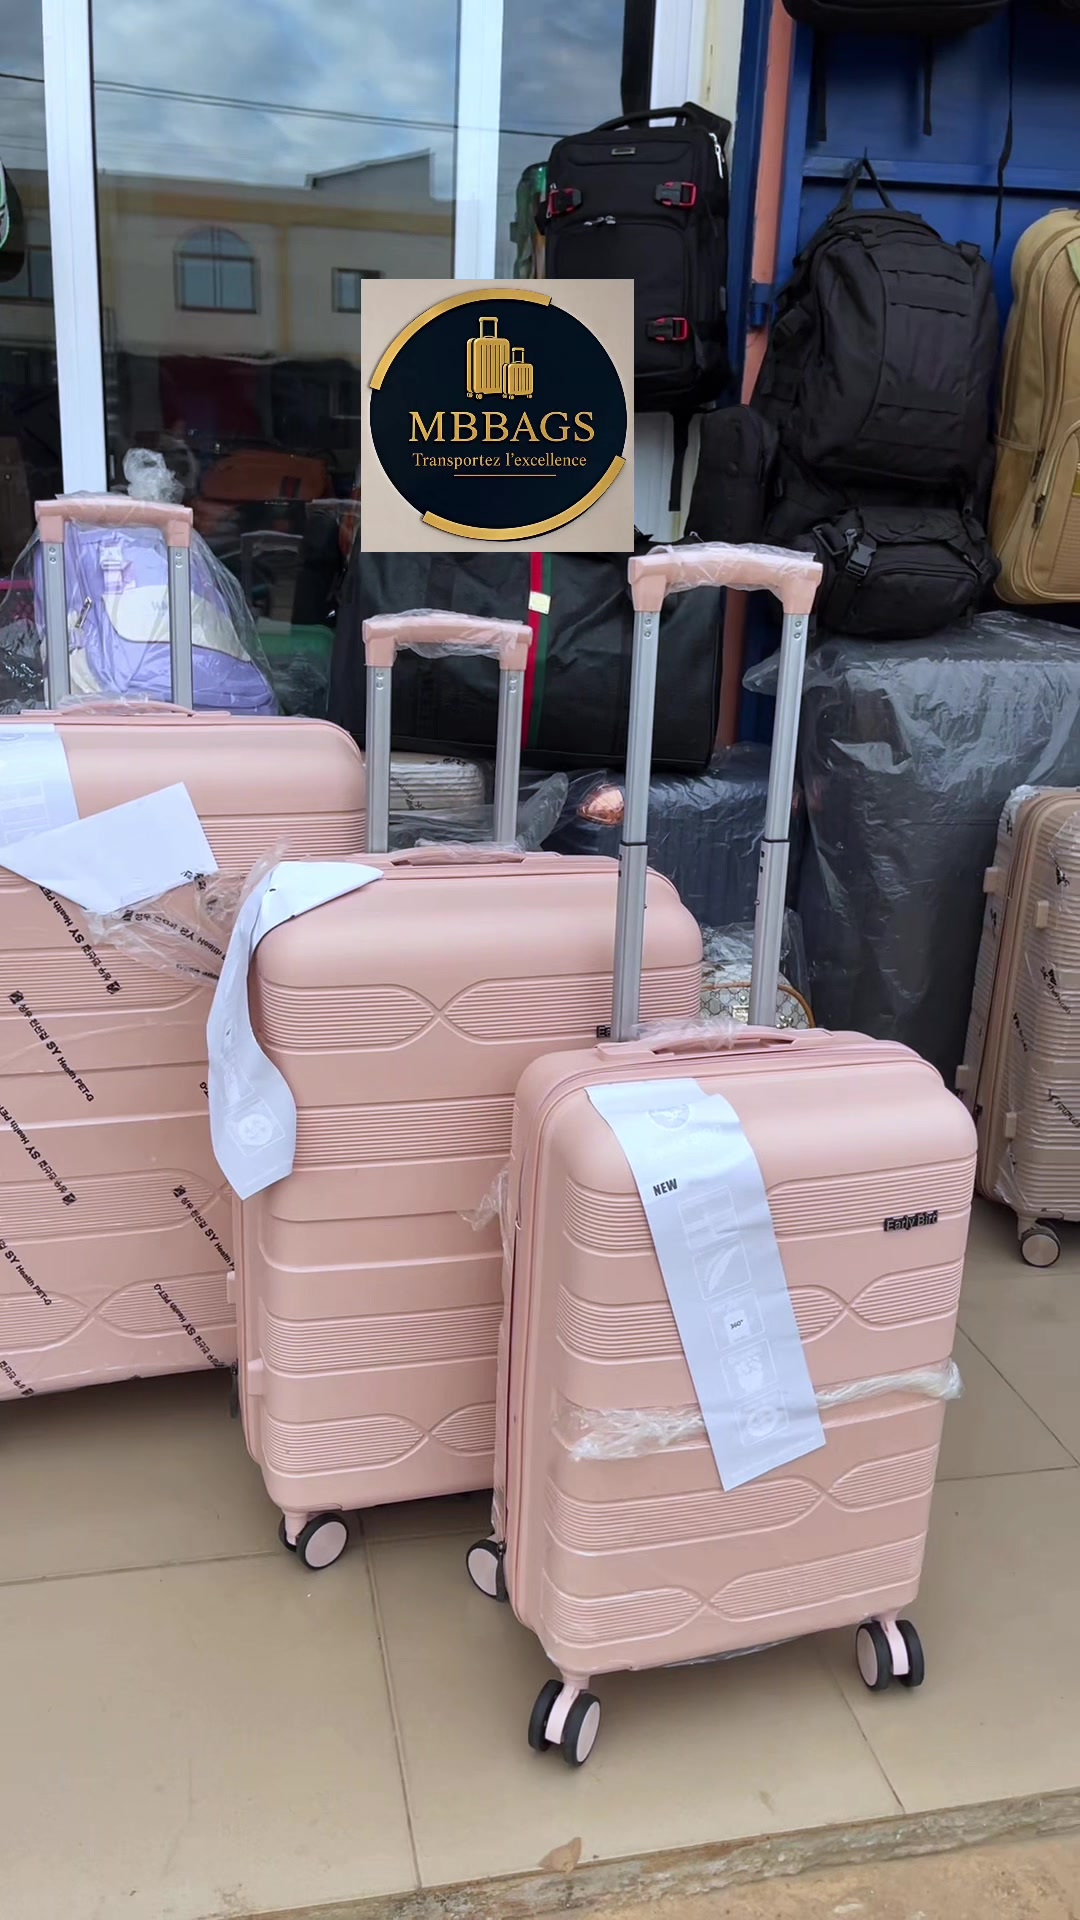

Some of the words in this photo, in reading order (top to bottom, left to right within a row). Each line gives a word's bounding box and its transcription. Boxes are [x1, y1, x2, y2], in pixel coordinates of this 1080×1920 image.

[53, 900, 73, 927] Health
[69, 929, 85, 944] SY
[46, 1041, 62, 1055] SY
[57, 1057, 76, 1080] Health
[74, 1079, 94, 1102] PET-G
[10, 1120, 30, 1145] Health
[25, 1146, 41, 1160] SY
[652, 1178, 678, 1196] NEW
[883, 1214, 915, 1231] Early
[915, 1210, 938, 1226] Bird
[204, 1228, 219, 1241] SY
[214, 1242, 231, 1263] Health
[5, 1250, 20, 1263] SY
[15, 1264, 35, 1287] Health
[33, 1285, 52, 1306] PET-G
[154, 1283, 172, 1304] PET-G
[182, 1323, 196, 1336] SY
